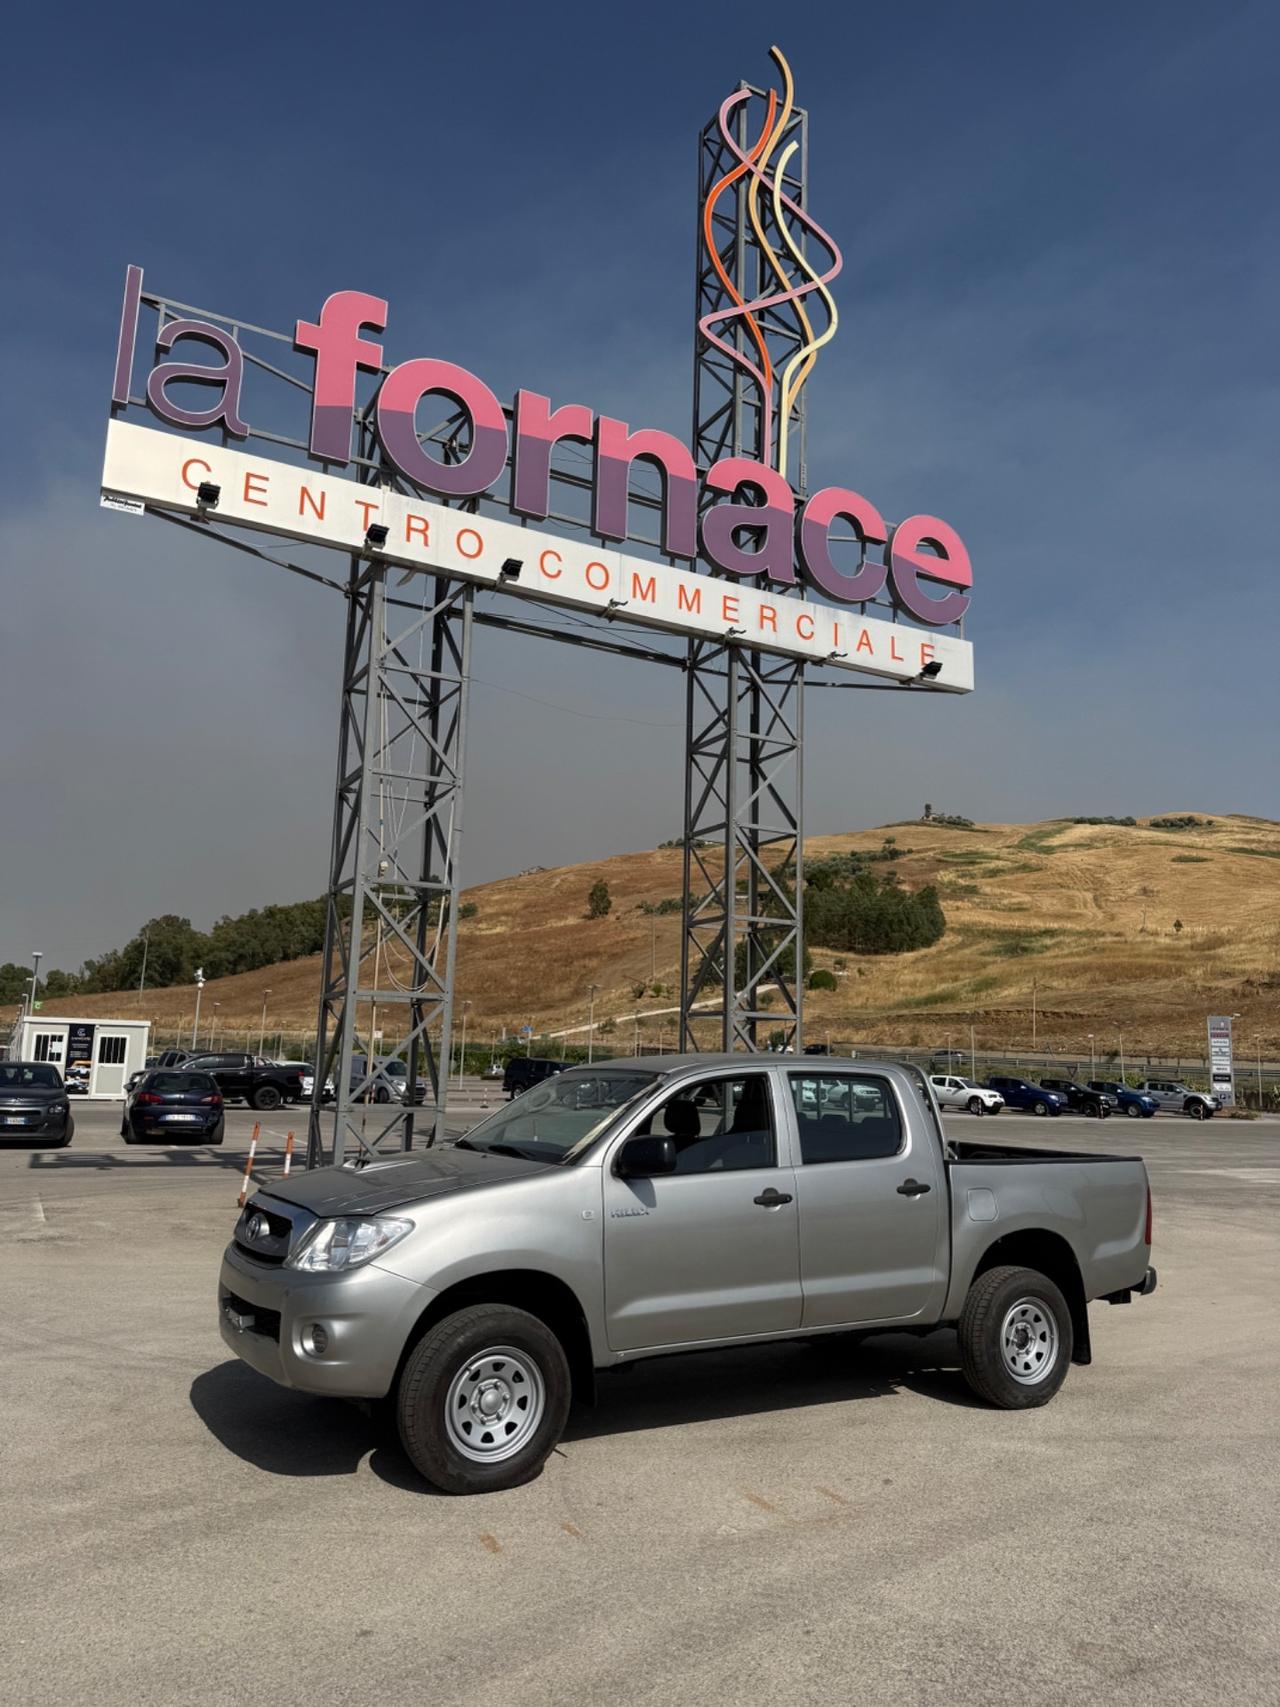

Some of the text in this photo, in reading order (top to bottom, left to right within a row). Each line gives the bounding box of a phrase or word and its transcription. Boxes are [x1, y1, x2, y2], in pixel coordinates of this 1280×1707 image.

[111, 264, 974, 625] la fornace
[181, 457, 936, 668] CENTRO COMMERCIALE
